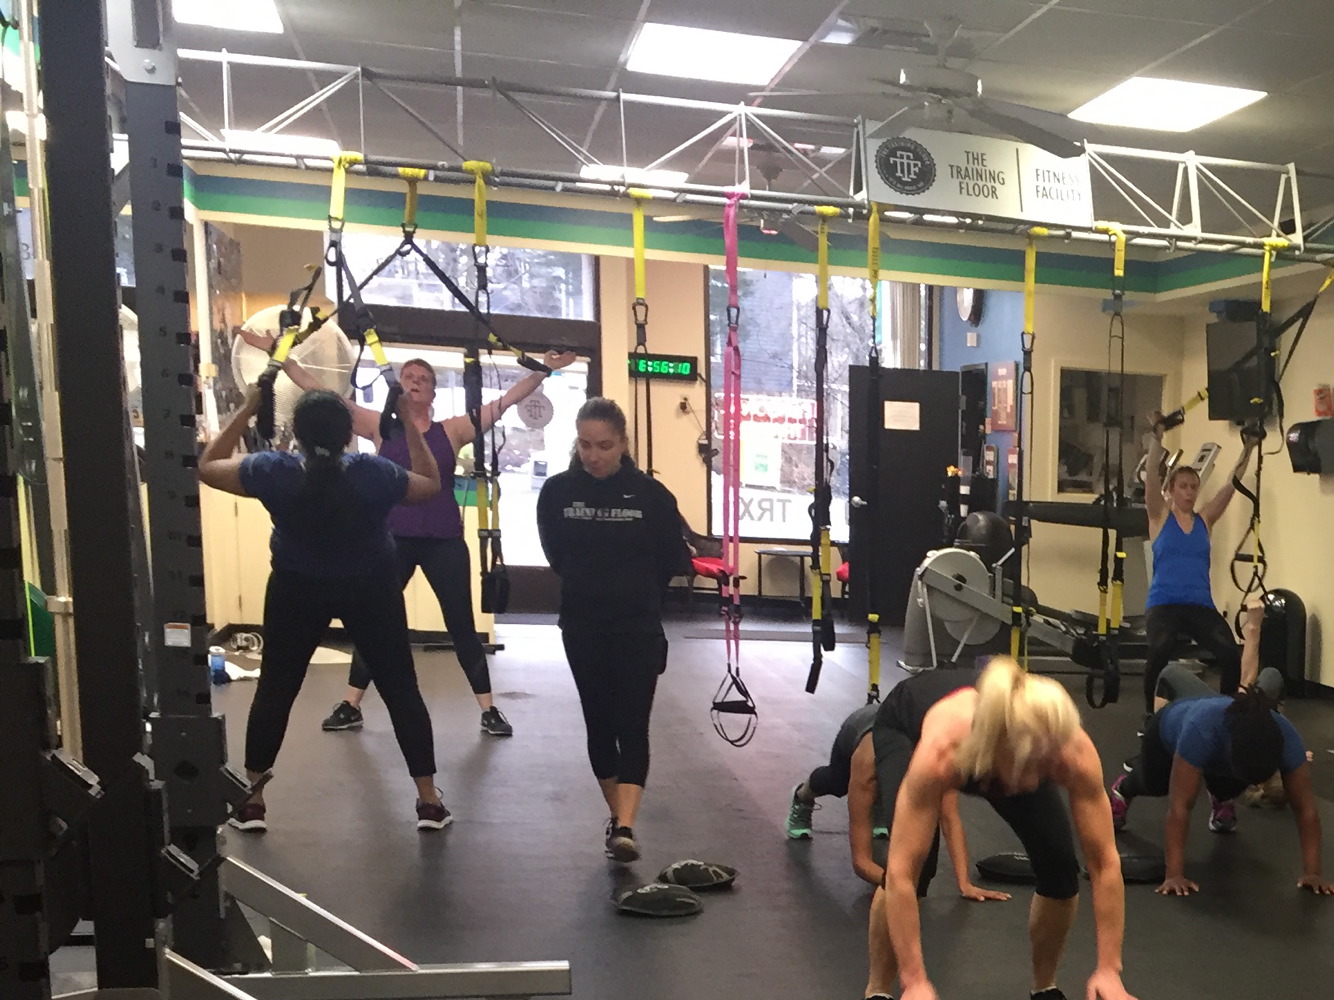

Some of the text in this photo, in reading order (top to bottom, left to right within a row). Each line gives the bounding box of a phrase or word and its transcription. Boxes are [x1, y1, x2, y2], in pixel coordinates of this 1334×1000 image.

[964, 150, 987, 168] THE
[948, 164, 1006, 186] TRAINING
[959, 181, 999, 200] FLOOR
[1035, 185, 1082, 202] FACILITY
